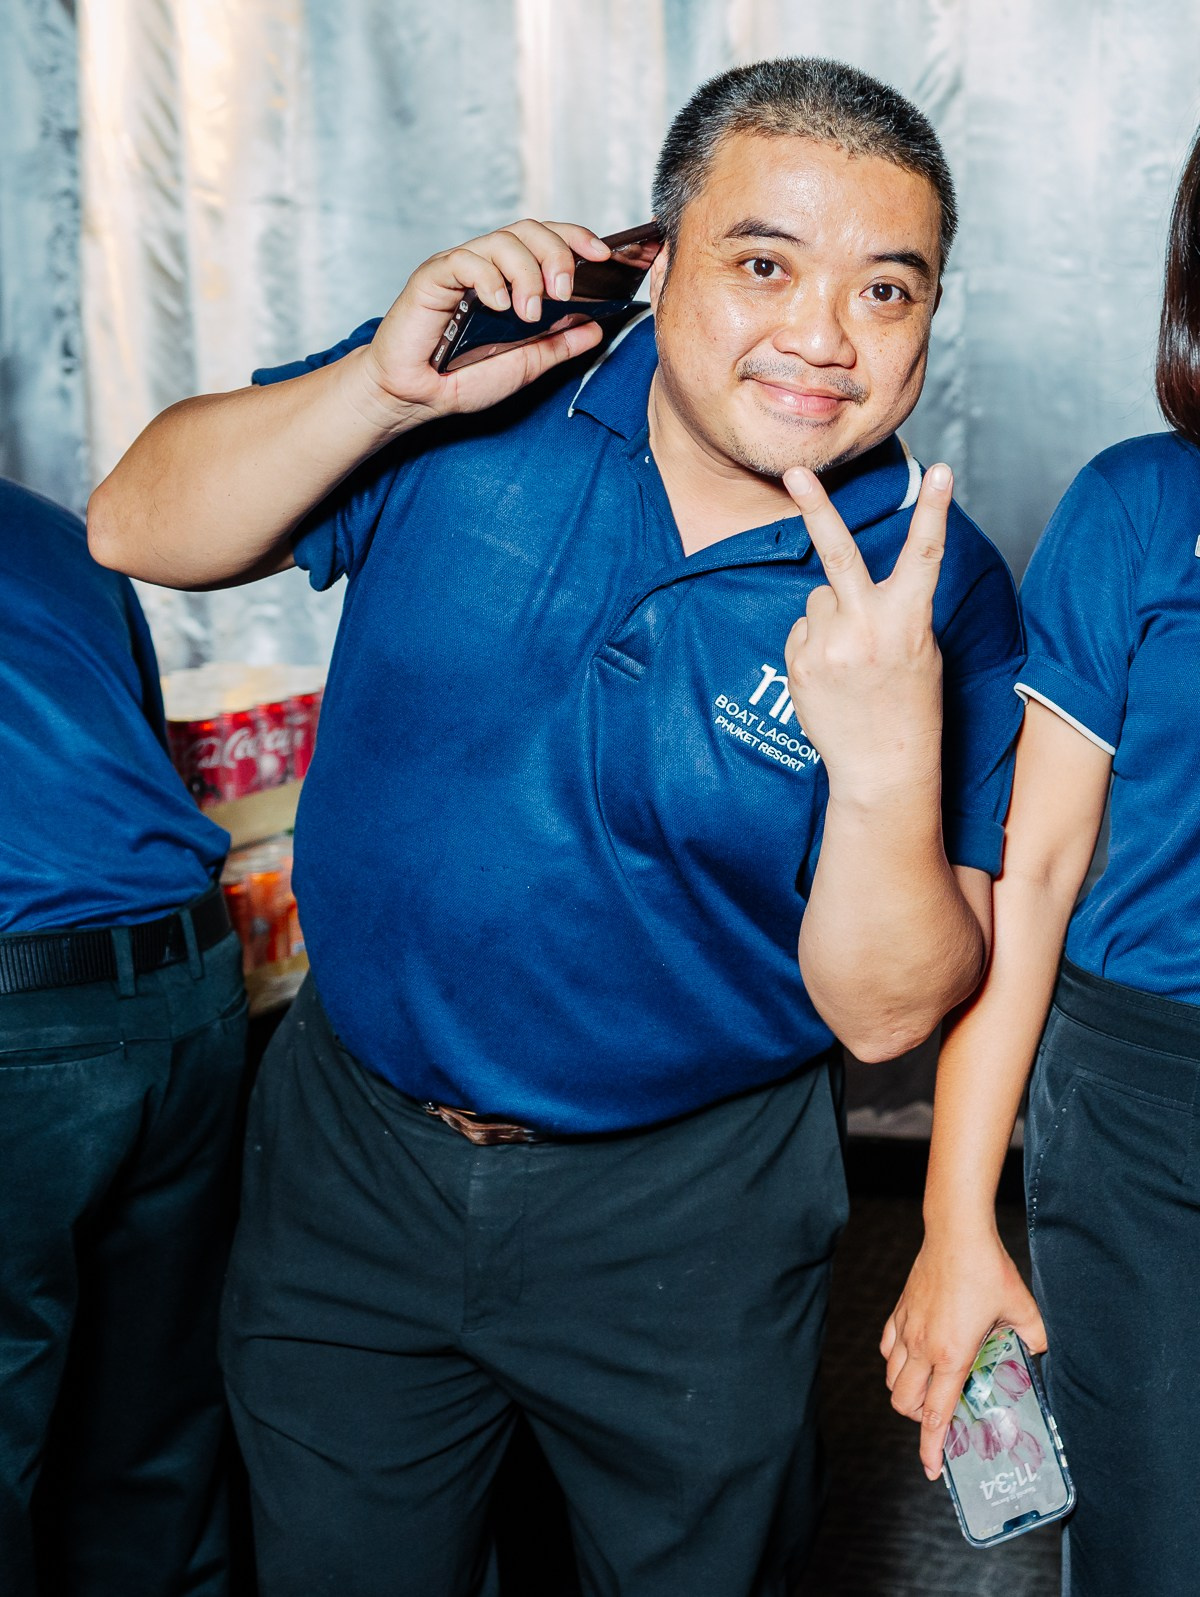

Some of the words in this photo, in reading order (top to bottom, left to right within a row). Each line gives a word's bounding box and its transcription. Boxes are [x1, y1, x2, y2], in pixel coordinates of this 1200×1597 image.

[714, 694, 758, 727] BOAT
[756, 720, 821, 764] LAGOON
[714, 715, 760, 747] PHUKET
[758, 742, 805, 772] RESORT
[979, 1462, 1037, 1500] 11:34
